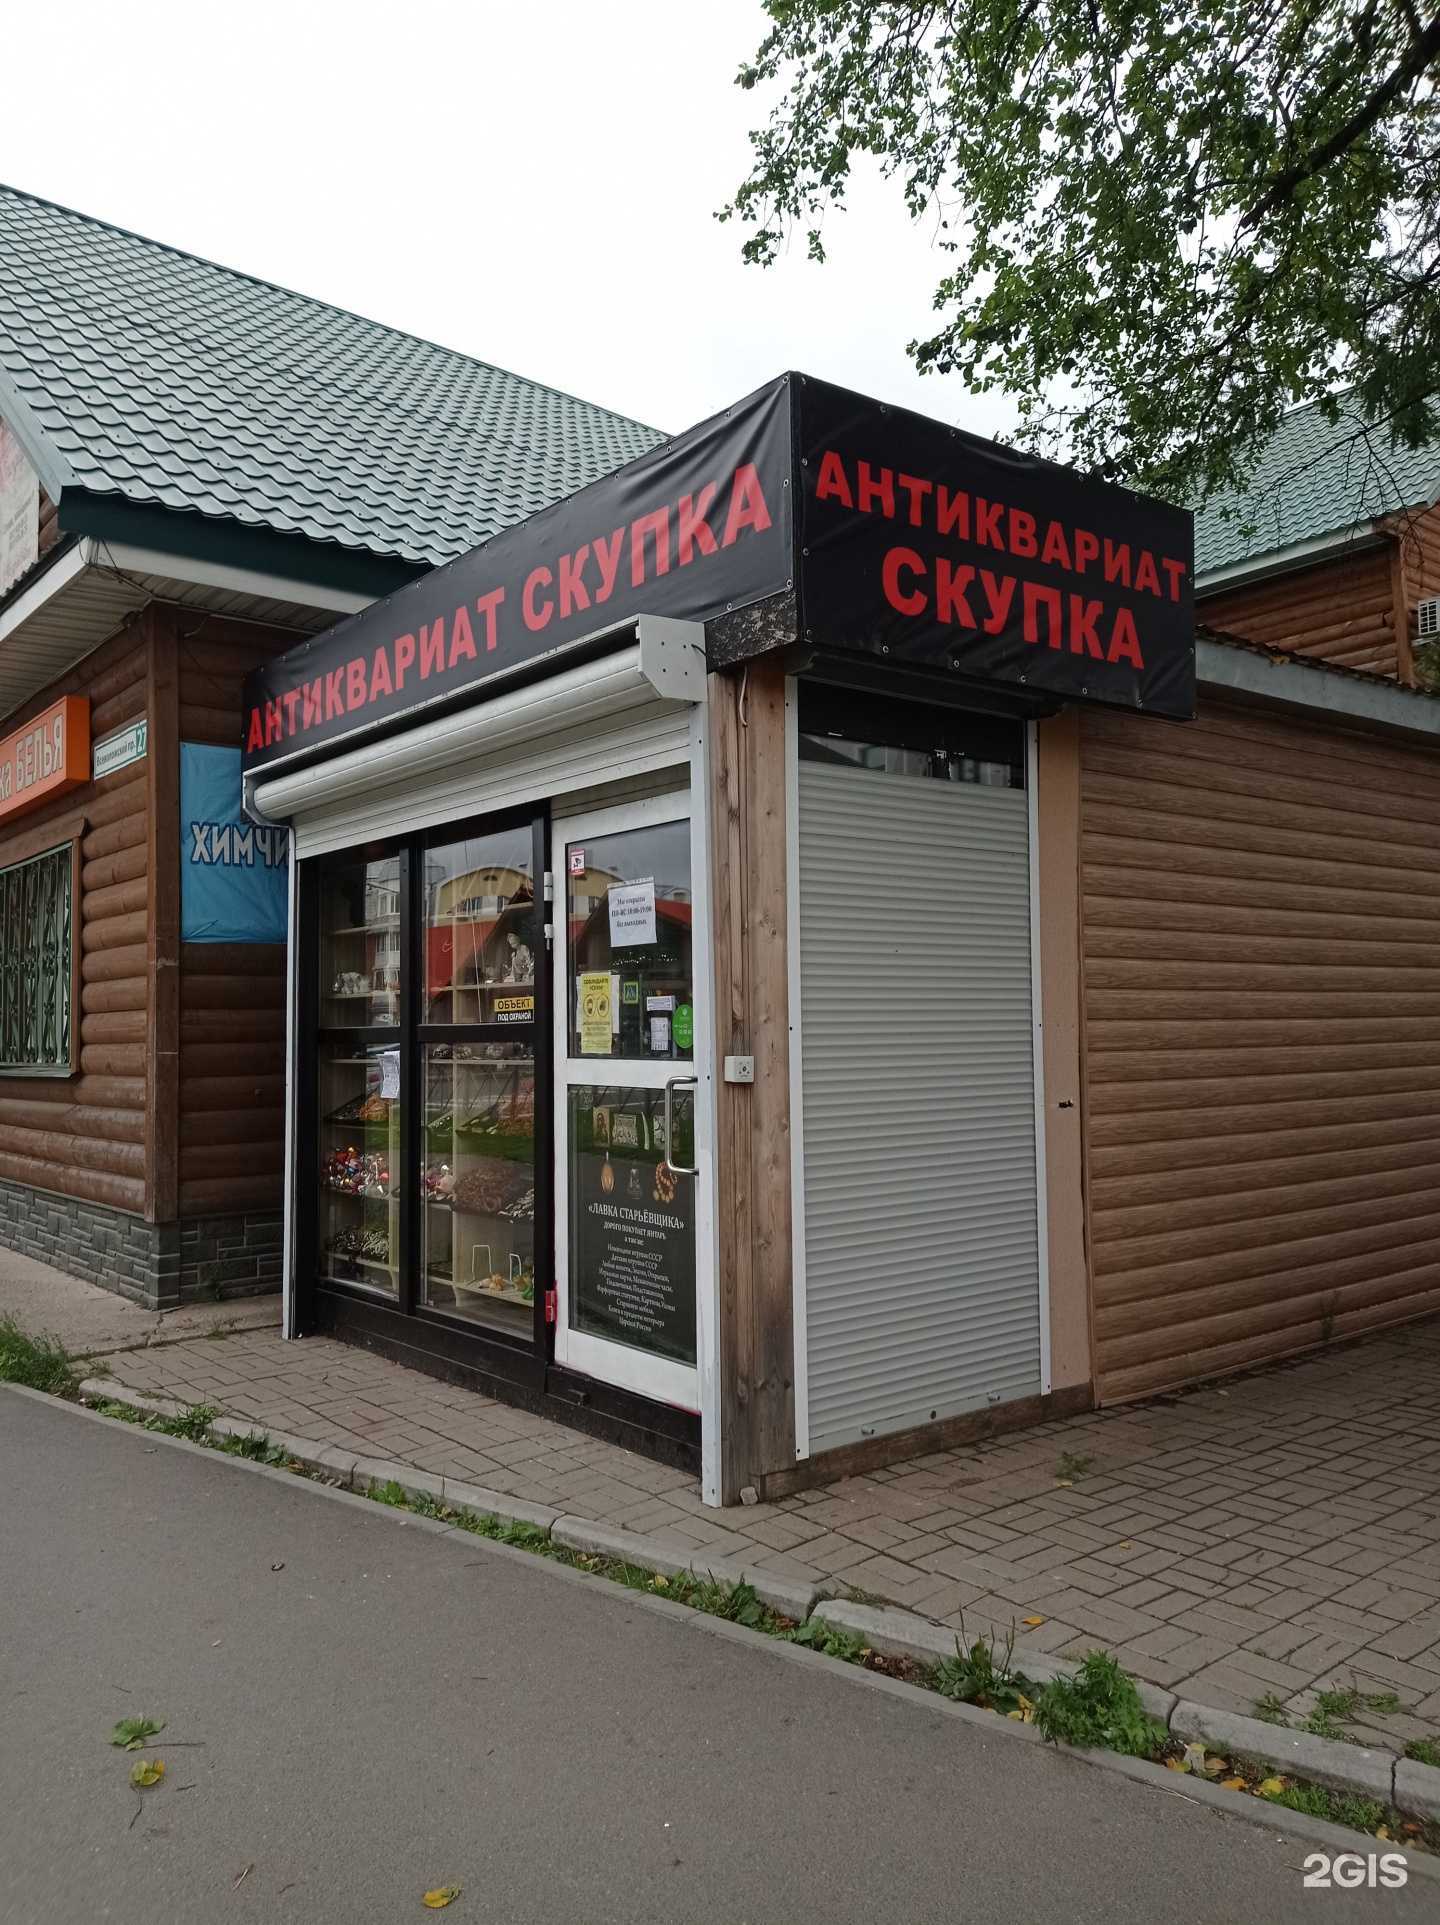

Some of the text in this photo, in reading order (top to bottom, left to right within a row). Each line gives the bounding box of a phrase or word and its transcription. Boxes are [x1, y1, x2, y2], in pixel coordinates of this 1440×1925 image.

[816, 450, 1187, 604] АНТИКВАРИАТ
[246, 462, 772, 753] АНТИКВАРИАТ СКУПКА
[882, 546, 1145, 670] СКУПКА
[15, 713, 64, 793] БЕЛЬЯ
[497, 998, 532, 1010] ОБЪЕКТ
[497, 1010, 532, 1022] ПОД ОХРАНОЙ
[588, 1202, 685, 1230] «ЛАВКА СТАРЬЁВЩИКА»
